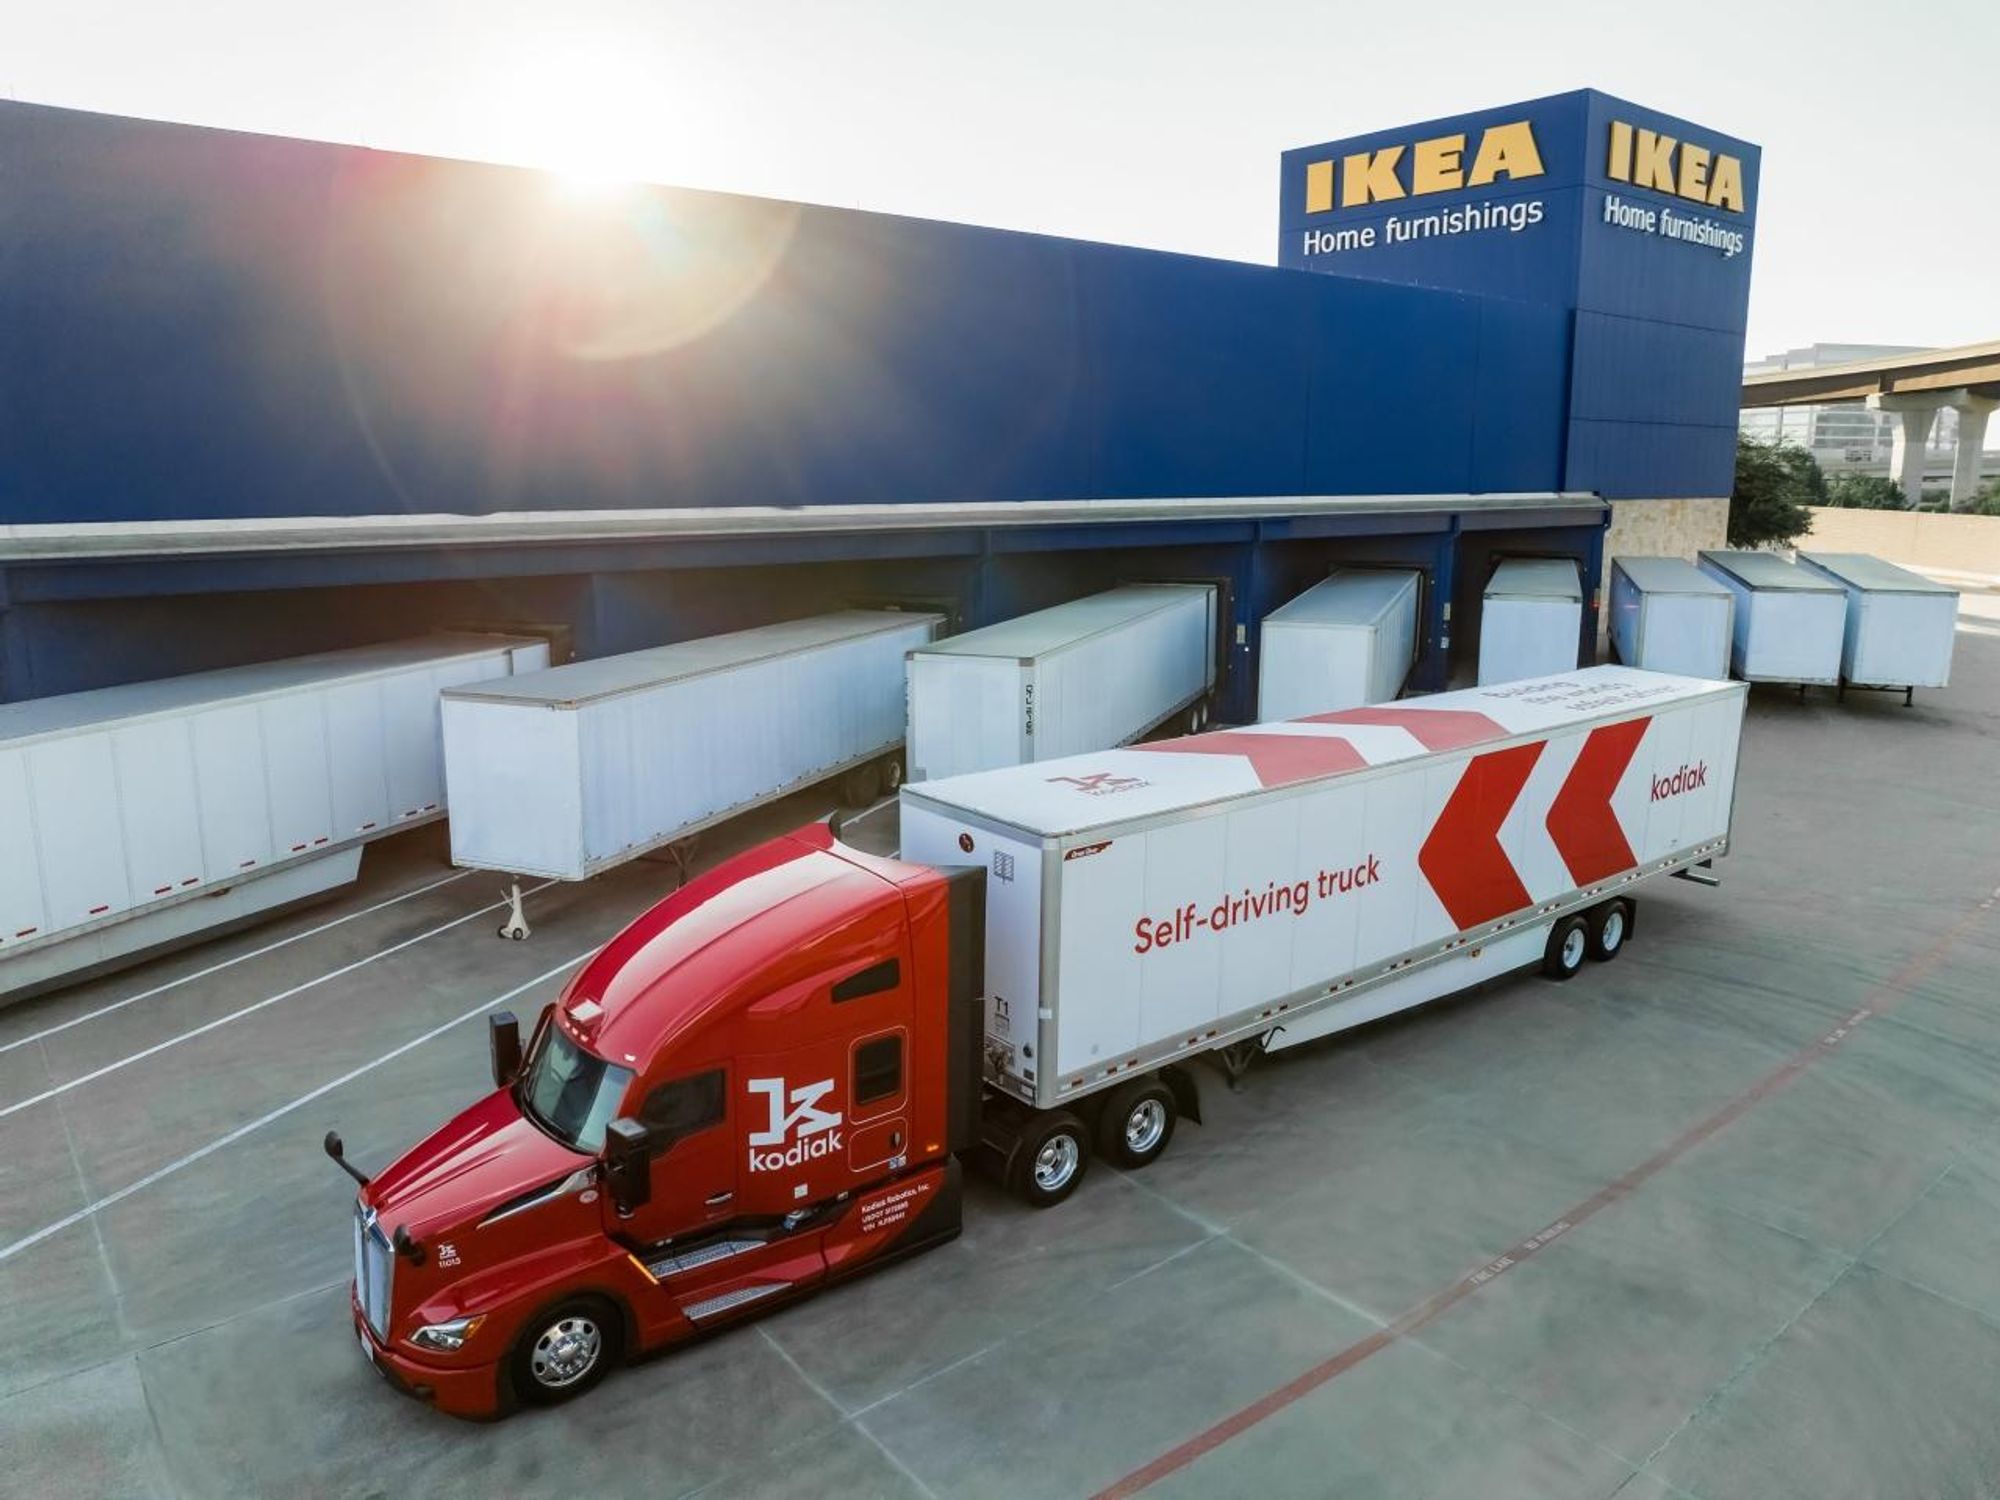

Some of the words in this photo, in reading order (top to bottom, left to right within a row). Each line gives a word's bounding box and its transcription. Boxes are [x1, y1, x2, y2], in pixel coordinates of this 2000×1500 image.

[1306, 121, 1545, 214] IKEA
[1608, 120, 1745, 213] IKEA
[1304, 224, 1376, 255] Home
[1386, 200, 1543, 245] furnishings
[1604, 195, 1656, 233] Home
[1659, 209, 1744, 257] furnishings
[1651, 761, 1707, 802] kodiak
[1134, 880, 1309, 954] Self-driving
[1317, 854, 1380, 899] truck
[750, 1129, 842, 1173] kodiak
